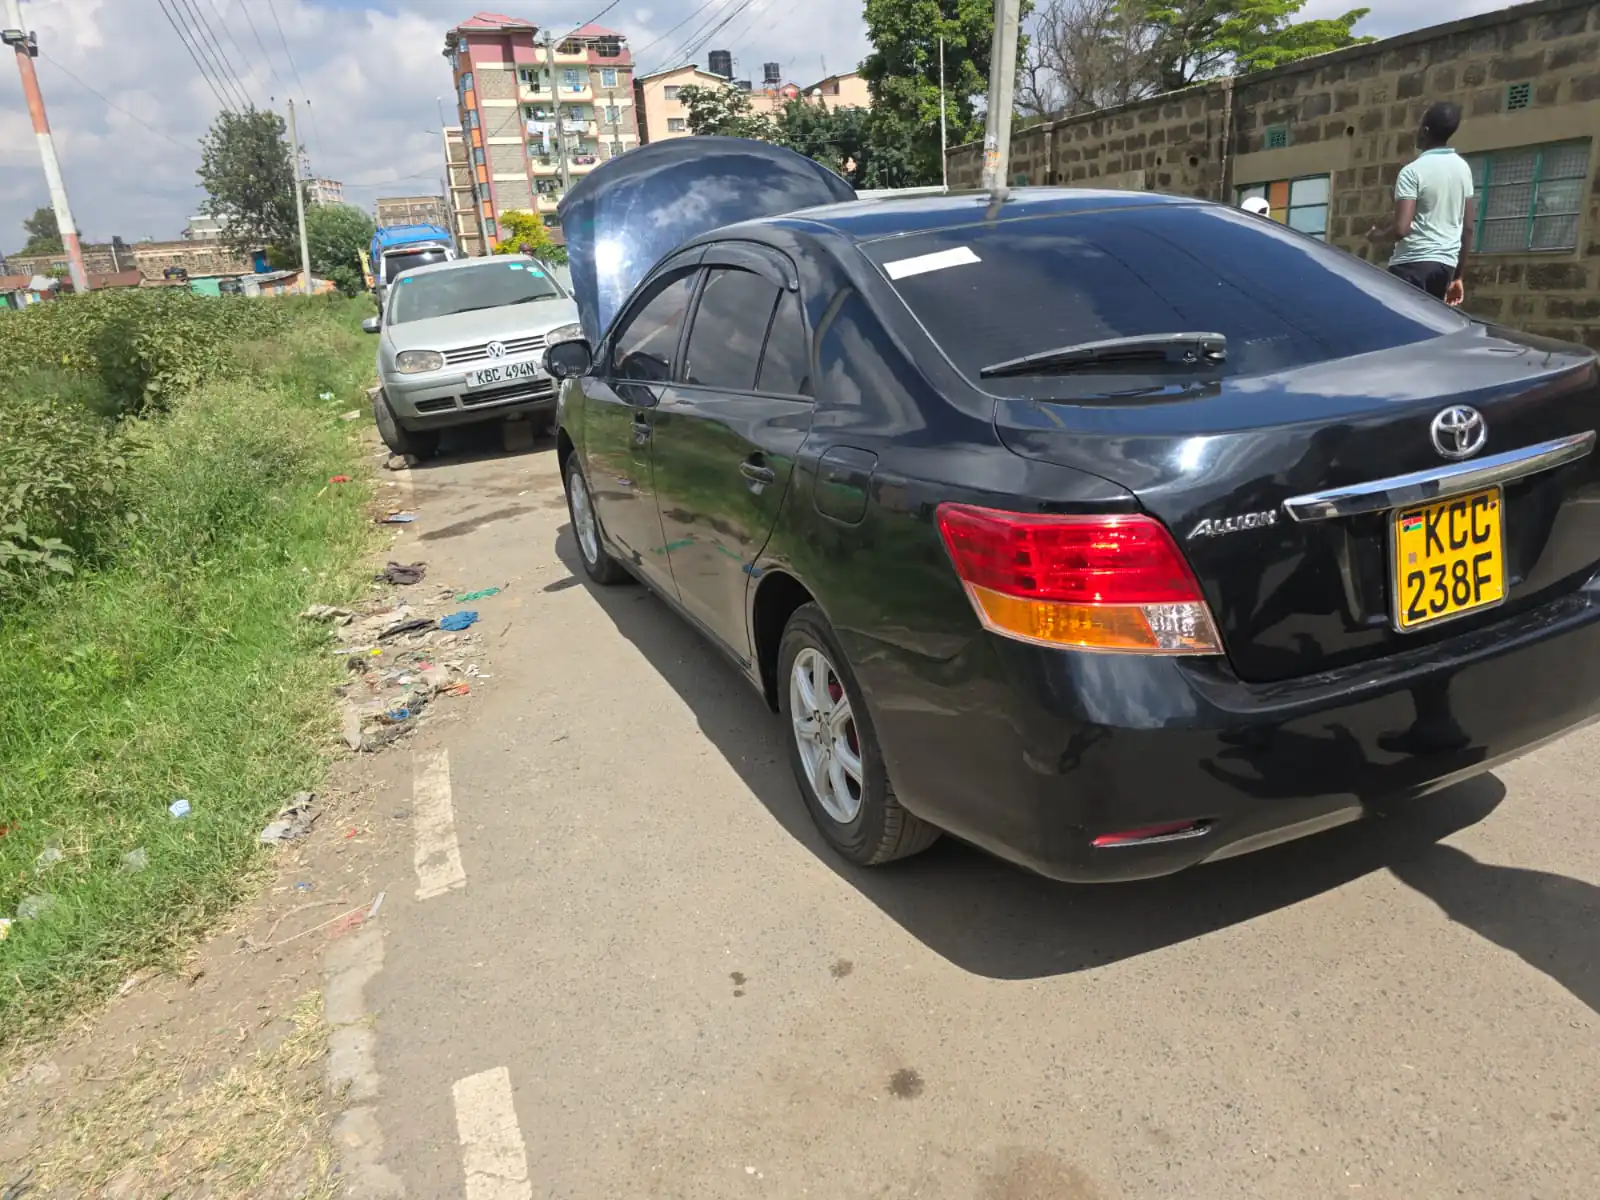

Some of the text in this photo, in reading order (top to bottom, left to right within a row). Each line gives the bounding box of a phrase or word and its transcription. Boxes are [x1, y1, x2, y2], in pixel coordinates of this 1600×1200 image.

[476, 362, 535, 384] KBC 494N
[1186, 509, 1277, 539] ALLION
[1425, 495, 1491, 558] KCC
[1407, 551, 1492, 621] 238F
